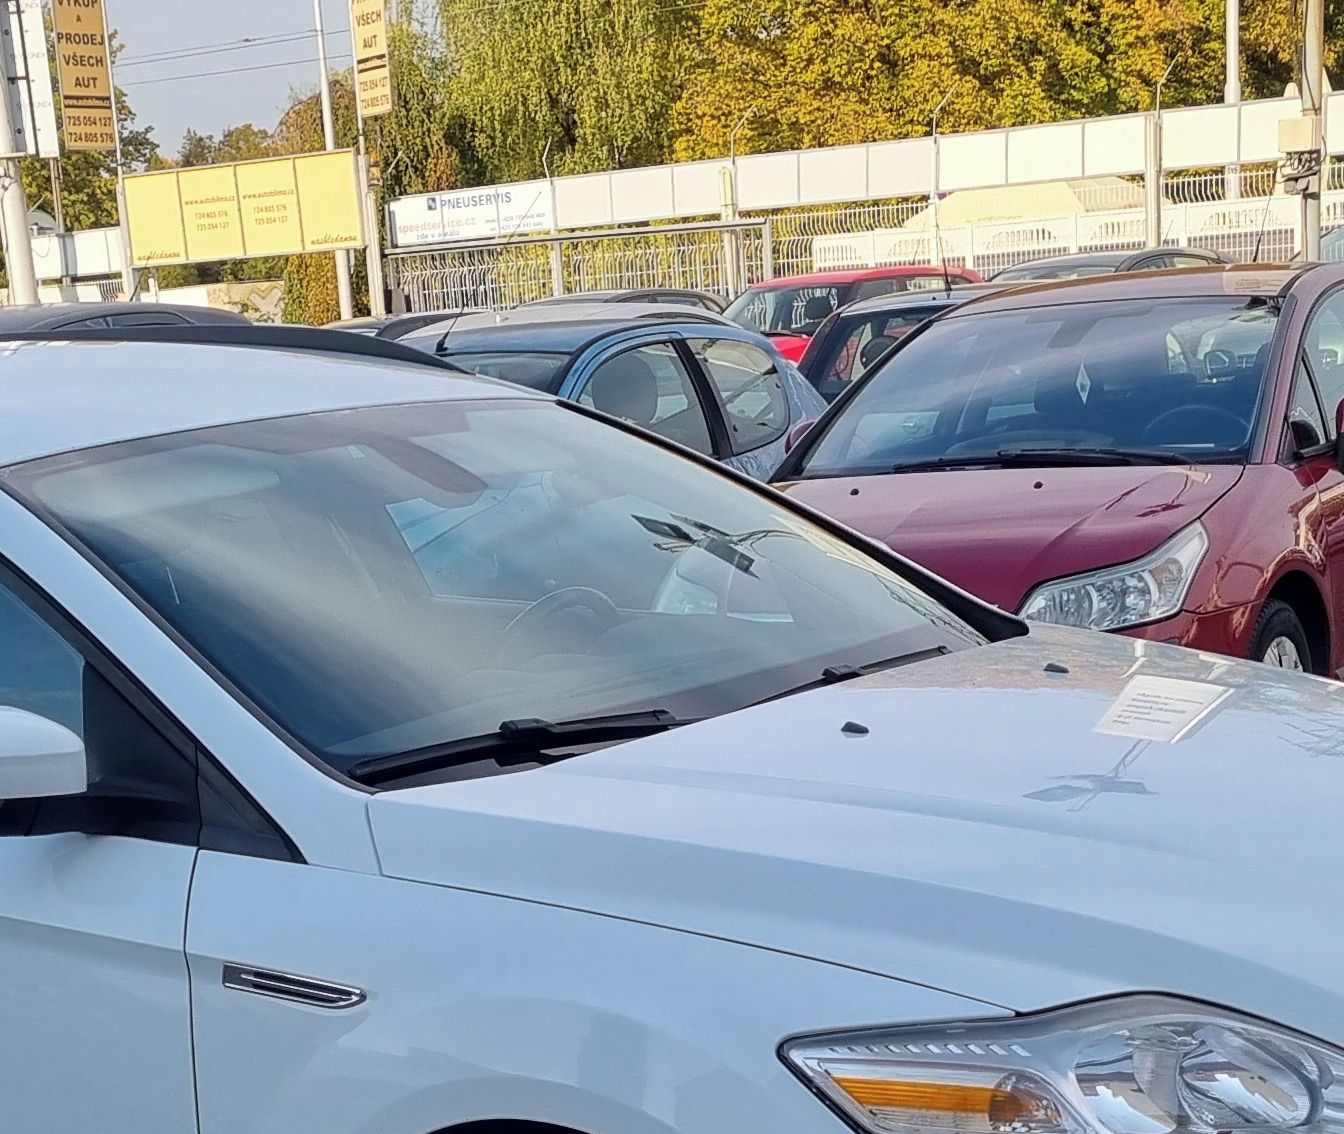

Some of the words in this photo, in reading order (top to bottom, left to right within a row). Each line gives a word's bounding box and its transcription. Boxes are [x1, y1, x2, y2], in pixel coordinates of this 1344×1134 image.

[75, 14, 82, 23] A
[356, 9, 382, 27] VŠECH
[56, 32, 105, 46] PRODEJ
[362, 34, 378, 49] AUT
[62, 51, 105, 68] VŠECH
[74, 77, 98, 89] AUT
[66, 115, 82, 126] 725
[82, 115, 97, 126] 054
[98, 116, 112, 127] 127
[67, 132, 83, 143] 724
[83, 132, 98, 143] 805
[99, 132, 114, 144] 576
[440, 191, 512, 211] PNEUSERVIS
[398, 217, 476, 234] speedserice.cz
